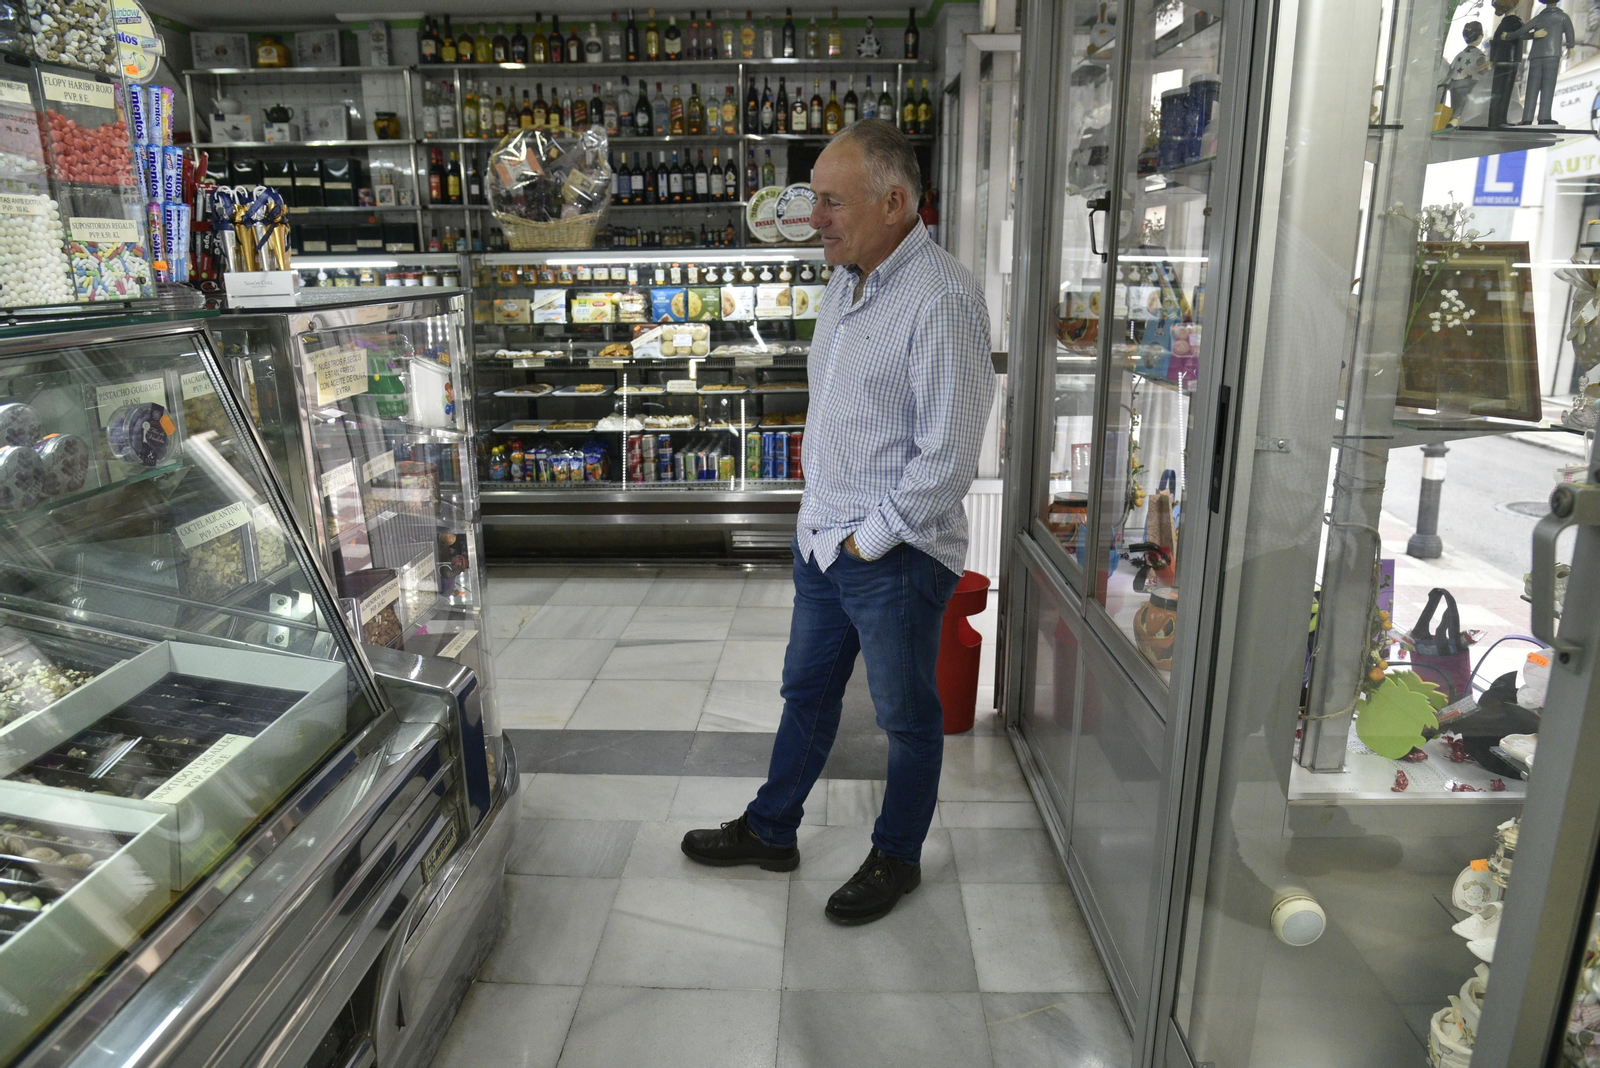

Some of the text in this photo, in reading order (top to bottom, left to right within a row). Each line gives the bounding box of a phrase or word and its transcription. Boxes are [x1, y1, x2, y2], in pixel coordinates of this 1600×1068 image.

[43, 76, 114, 95] FLOPY HARIBO ROJO.
[1554, 80, 1593, 97] UTOESCUELA
[63, 91, 78, 101] PVP.
[131, 91, 144, 140] mentos
[1549, 153, 1600, 176] AUT
[148, 151, 159, 198] mentos
[165, 174, 173, 202] ntos
[25, 198, 43, 207] EXTRA
[1474, 195, 1519, 204] AUTOESCUELA
[71, 222, 111, 230] SUPOSITORIOS
[166, 209, 174, 255] mentos
[89, 231, 101, 239] PVP.
[318, 358, 343, 371] NUESTROS
[319, 381, 330, 391] CON
[330, 376, 346, 387] ACEITE
[346, 374, 353, 383] DE
[336, 385, 352, 396] EXTRA
[98, 381, 163, 402] PISTACHO GOURMET
[179, 520, 207, 537] COCTEL
[199, 529, 213, 542] PVP.
[152, 734, 239, 800] SURTIDO VERSALLES.
[184, 773, 207, 789] PVP.
